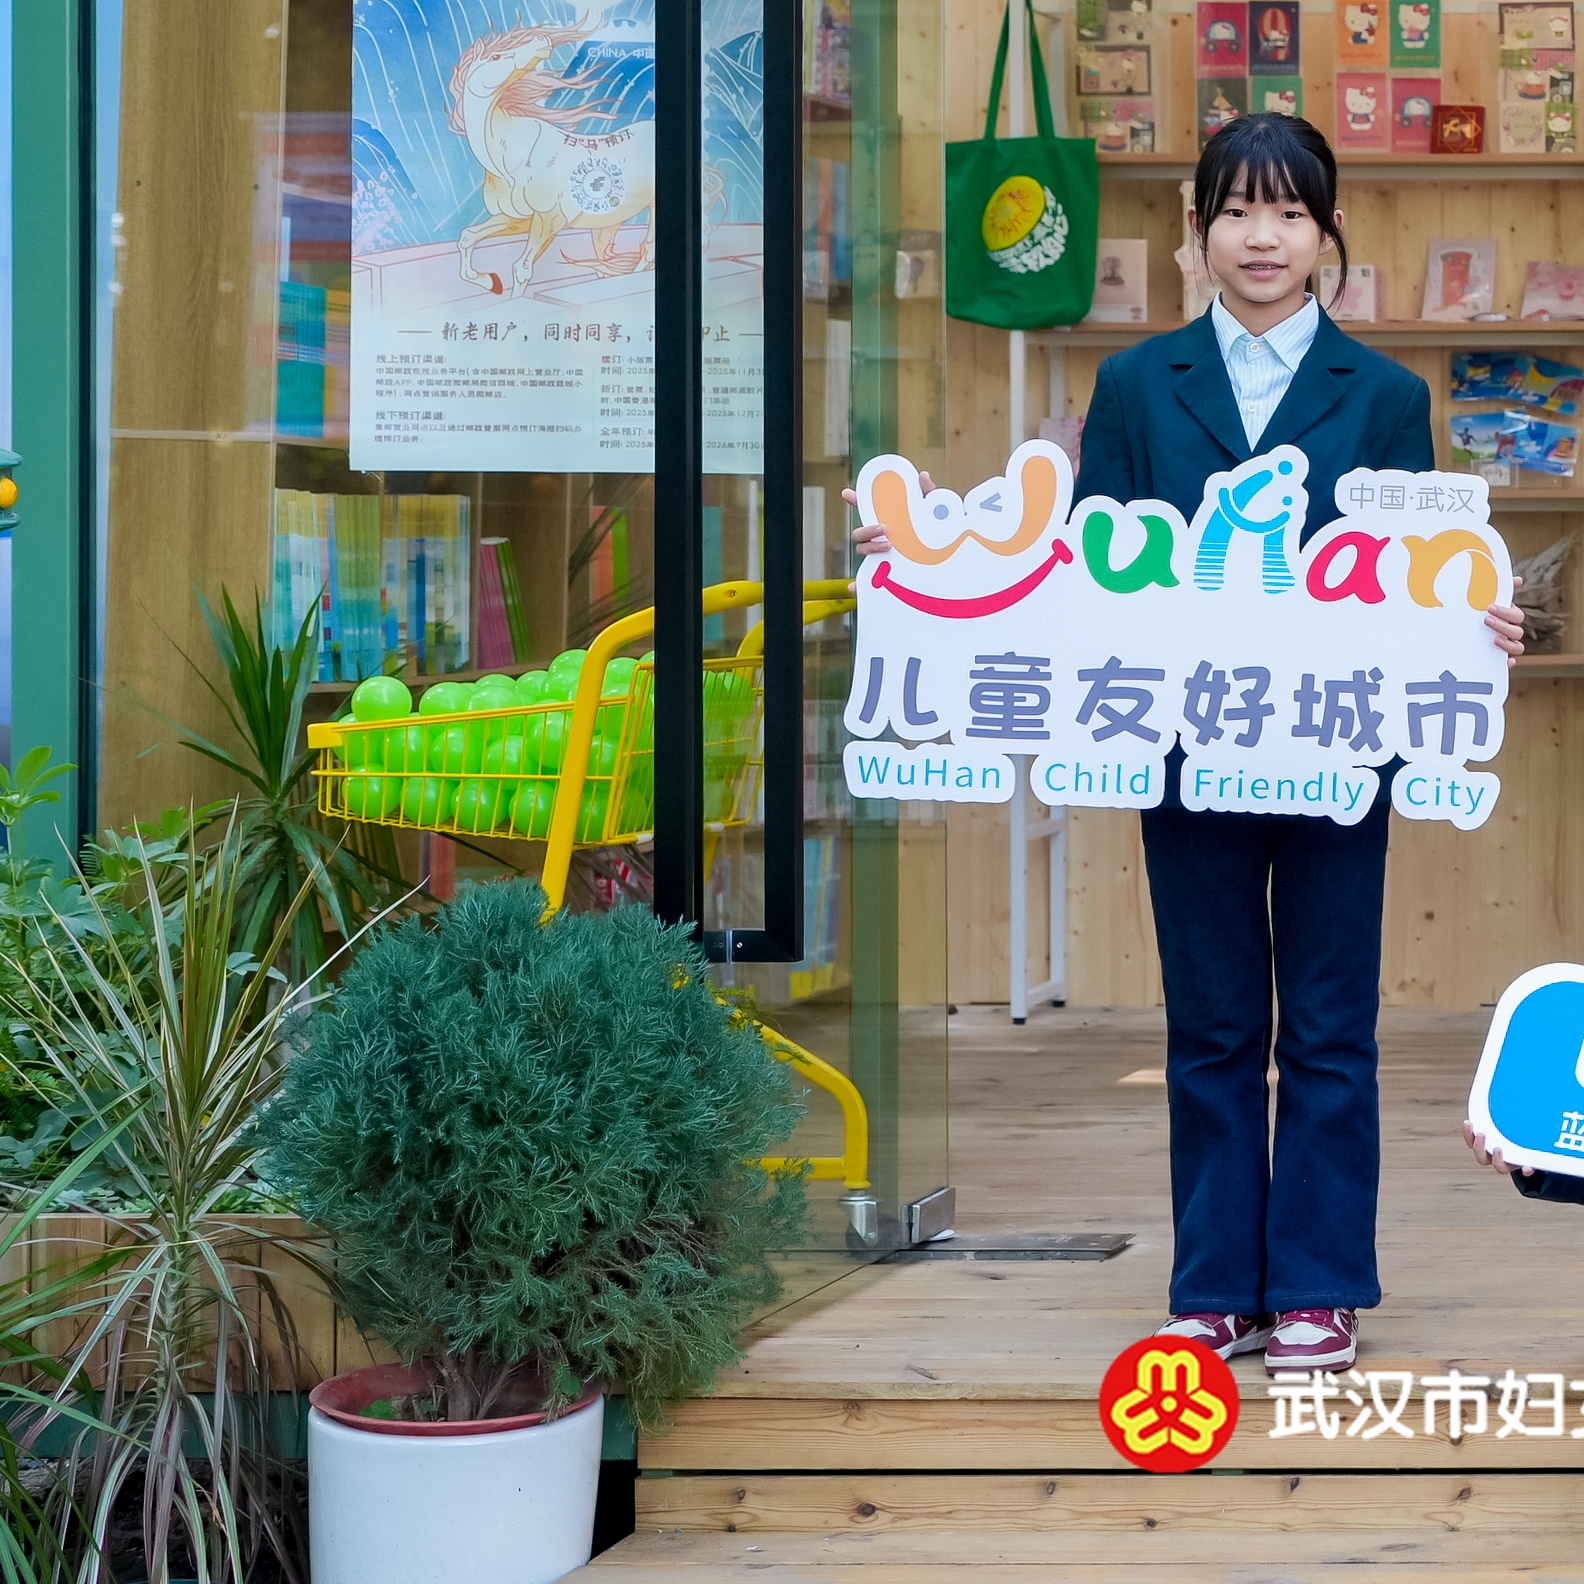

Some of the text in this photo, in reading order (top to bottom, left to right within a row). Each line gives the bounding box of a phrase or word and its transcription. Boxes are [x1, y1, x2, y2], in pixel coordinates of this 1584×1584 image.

[859, 651, 1494, 756] 儿童友好城市
[857, 755, 1485, 816] WuHan Child Friendly City
